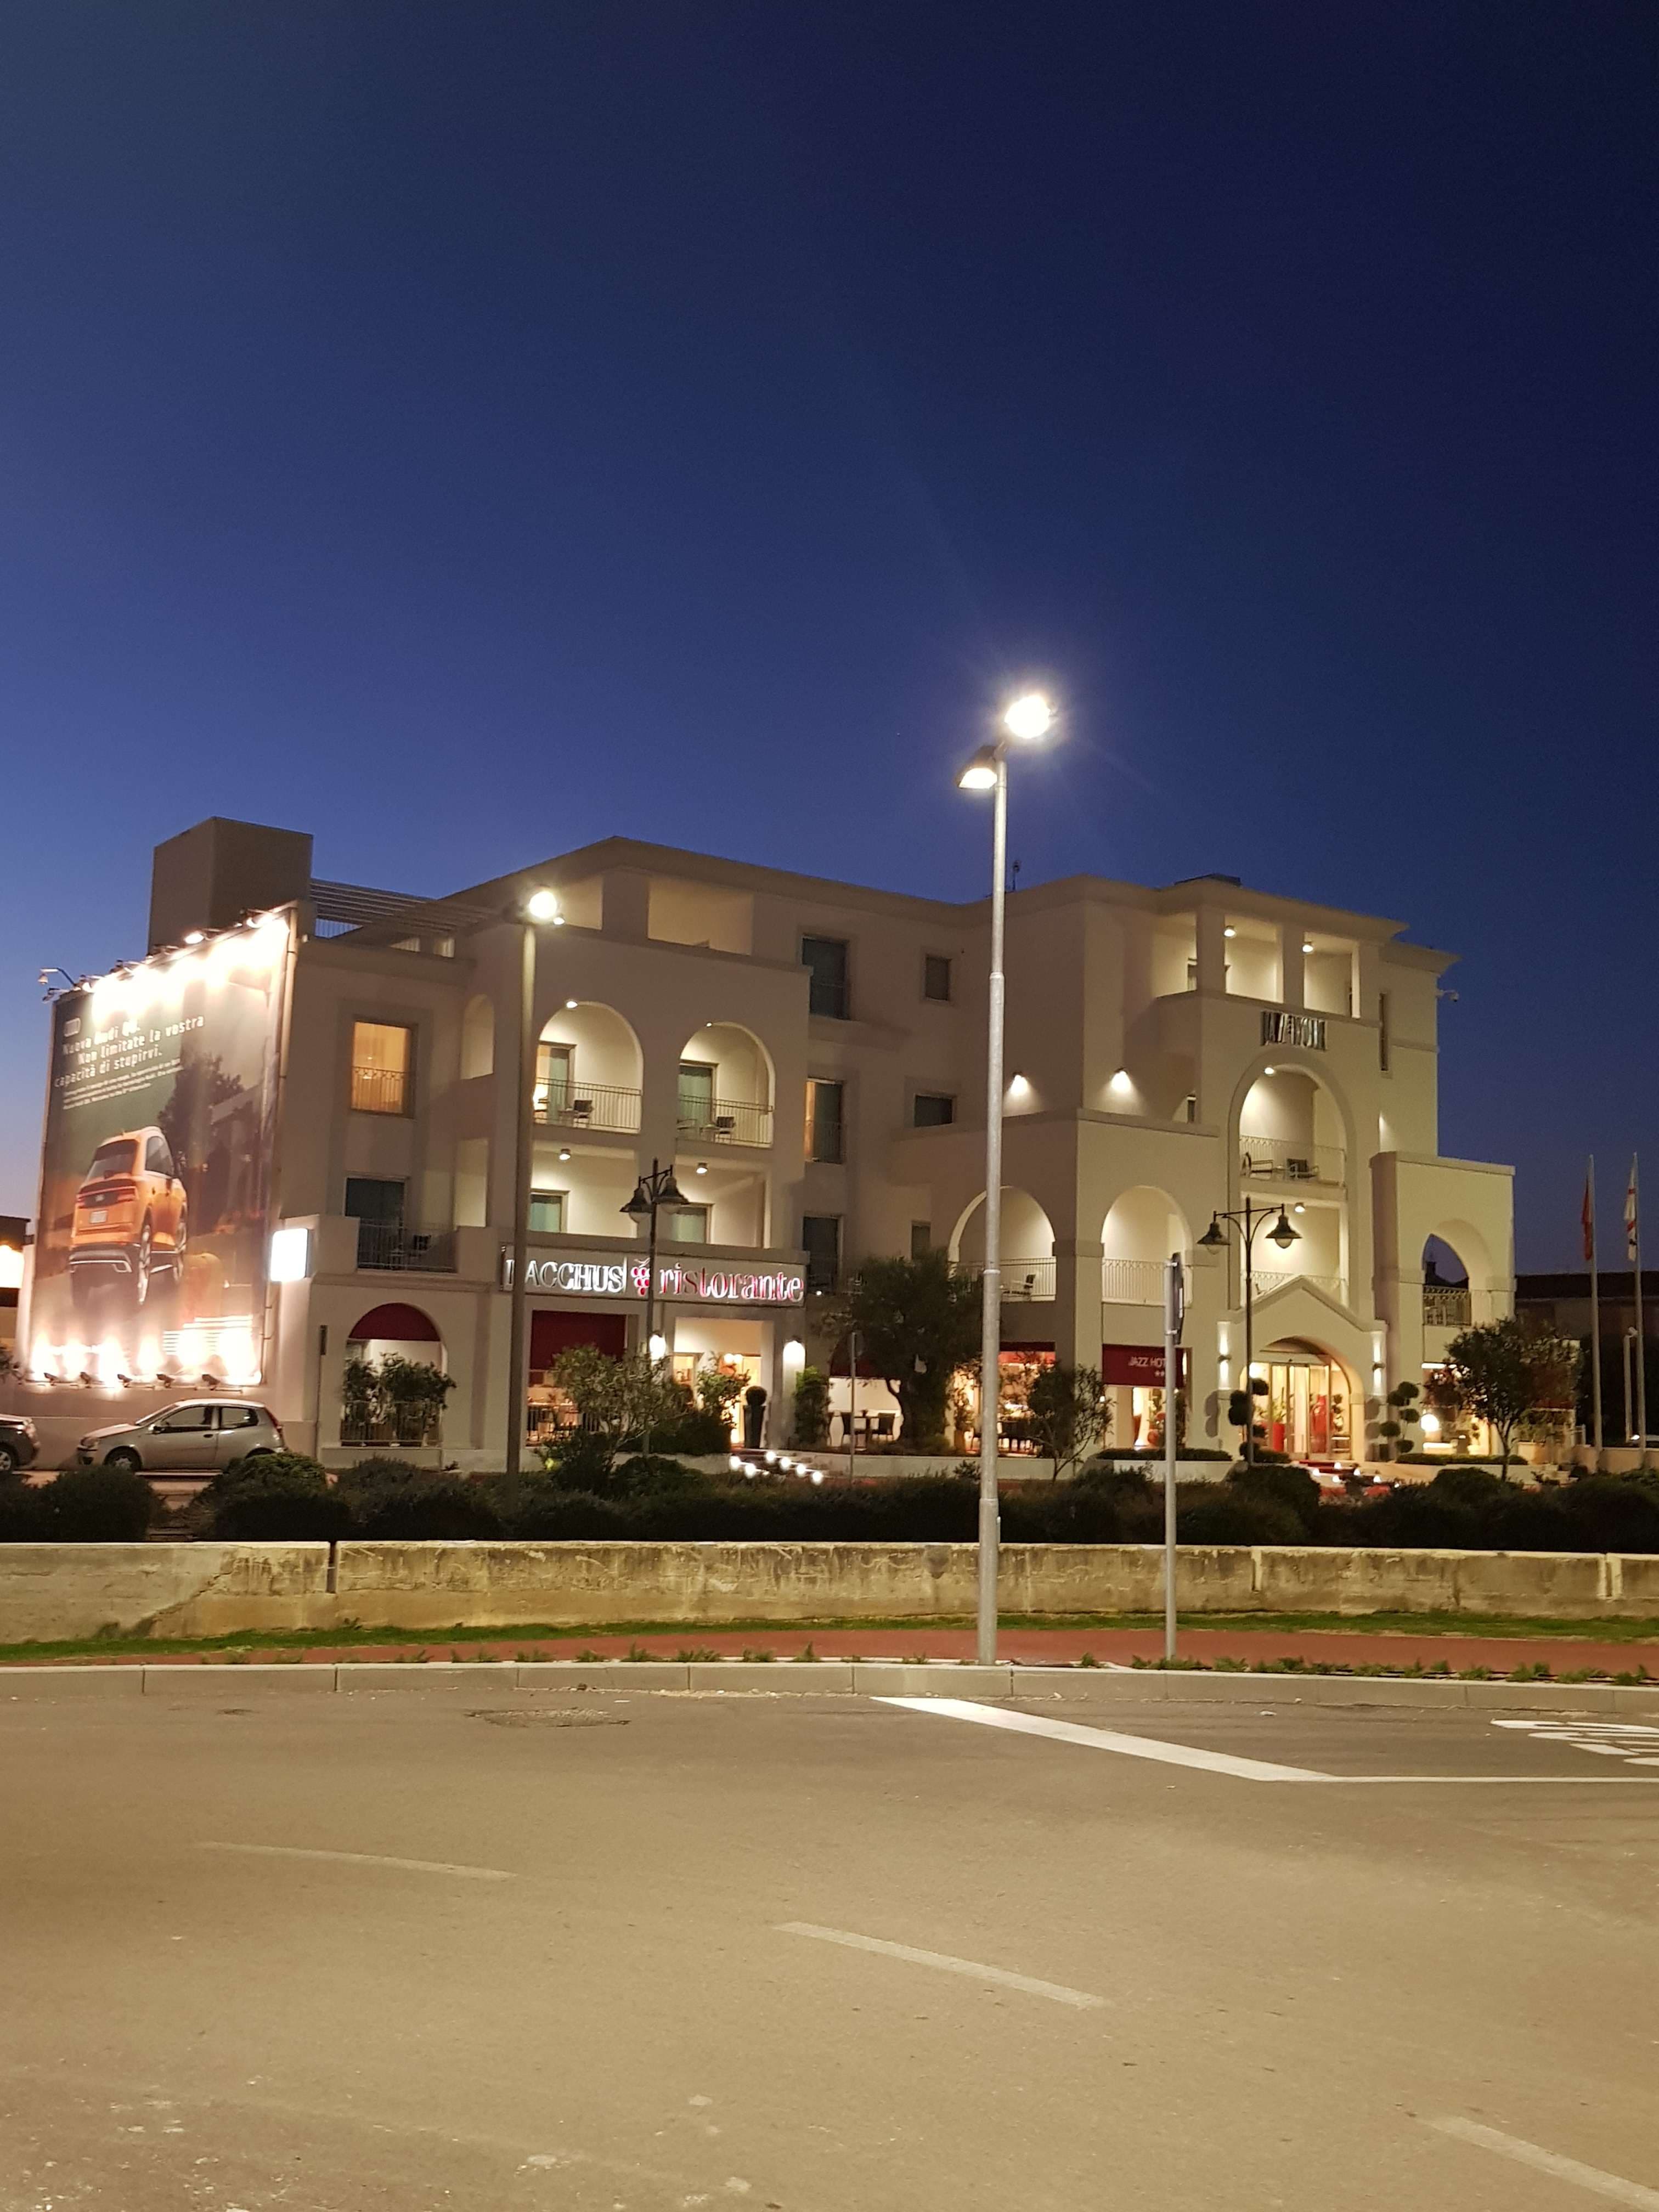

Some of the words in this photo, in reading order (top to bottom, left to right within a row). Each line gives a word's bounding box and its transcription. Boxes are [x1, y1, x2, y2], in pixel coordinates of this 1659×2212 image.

[101, 1035, 145, 1058] limitate
[149, 1029, 161, 1043] la
[166, 1016, 204, 1036] vostra
[55, 1064, 95, 1087] capacità
[99, 1059, 110, 1074] di
[114, 1044, 162, 1069] stupirvi.
[659, 1262, 804, 1302] ristorante
[1128, 1356, 1149, 1367] JAZZ
[1150, 1357, 1167, 1367] HOT
